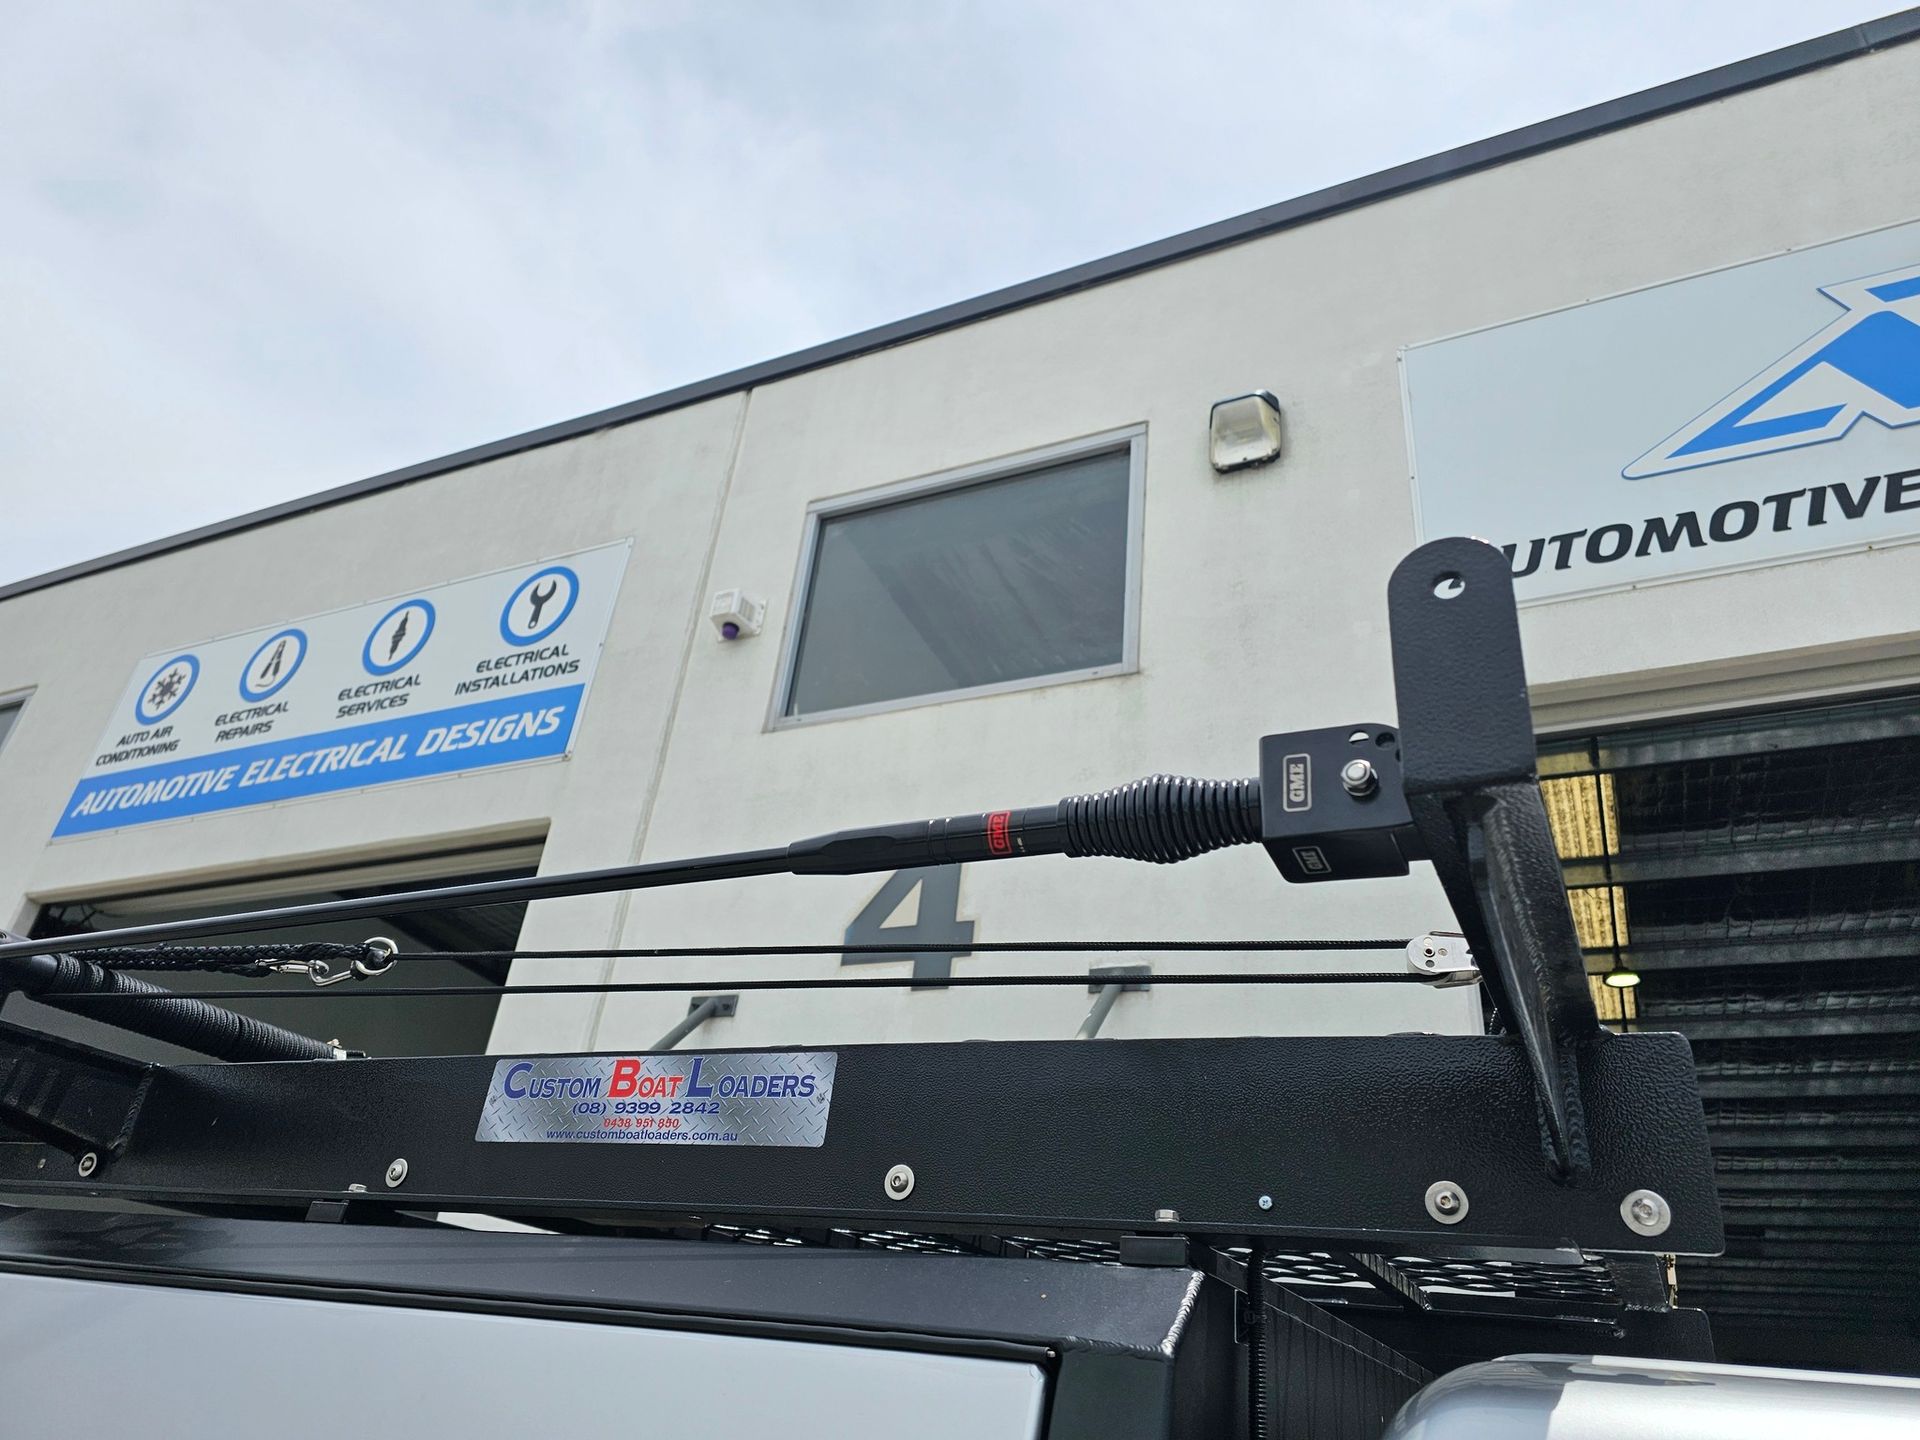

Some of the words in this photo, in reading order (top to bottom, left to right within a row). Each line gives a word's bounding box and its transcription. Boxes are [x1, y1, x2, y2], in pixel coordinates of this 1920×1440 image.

[1500, 469, 1920, 578] UTOMOTIVE
[475, 644, 569, 673] ELECTRICAL
[337, 674, 421, 701] ELECTRICAL
[454, 659, 580, 696] INSTALLATIONS
[214, 701, 289, 726] ELECTRICAL
[336, 693, 410, 719] SERVICES
[116, 730, 150, 747] AUTO
[149, 725, 174, 743] AIR
[214, 720, 274, 743] REPAIRS
[70, 765, 240, 818] AUTOMOTIVE
[238, 734, 409, 788] ELECTRICAL
[415, 705, 566, 757] DESIGNS
[95, 739, 180, 767] CONDITIONING
[1289, 763, 1305, 802] GME
[840, 862, 975, 992] 4
[503, 1061, 600, 1099] CUSTOM
[606, 1058, 685, 1098] BOAT
[685, 1057, 817, 1099] LOADERS
[572, 1102, 607, 1115] (08)
[614, 1102, 661, 1114] 9399
[668, 1102, 720, 1115] 2842
[546, 1129, 738, 1141] www.customboatloaders.com.au
[635, 1118, 653, 1128] 951
